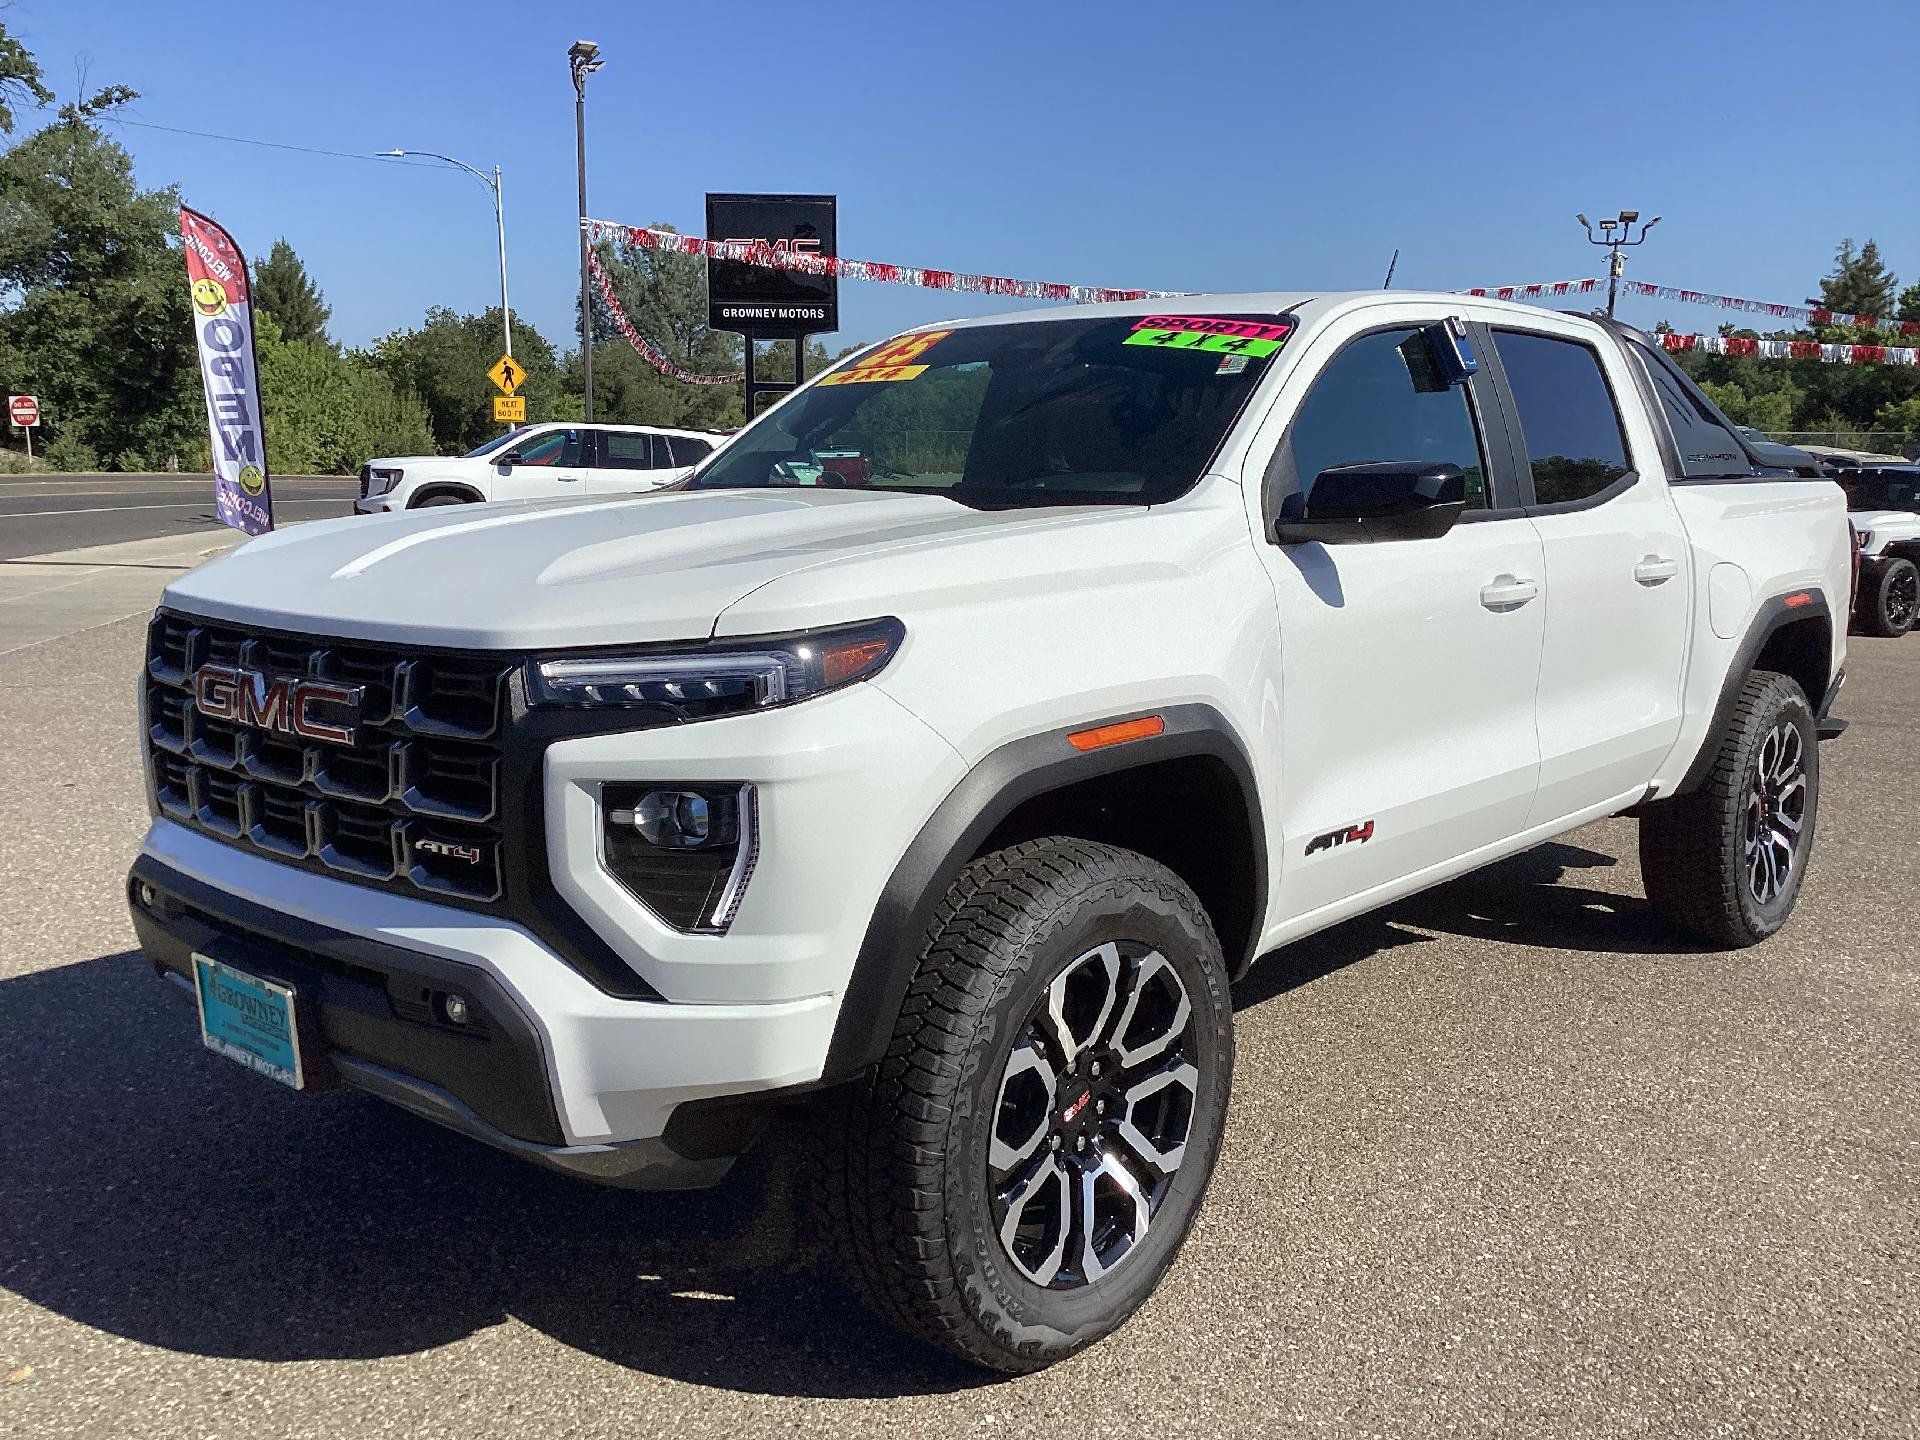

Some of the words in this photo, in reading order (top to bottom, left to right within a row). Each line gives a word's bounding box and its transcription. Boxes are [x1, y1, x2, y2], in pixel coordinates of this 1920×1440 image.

[722, 308, 777, 318] GROWNEY
[778, 308, 825, 319] MOTORS
[1139, 317, 1280, 338] SPORTY
[196, 662, 365, 745] GMC
[1304, 820, 1374, 856] AT4
[416, 840, 479, 864] AT4
